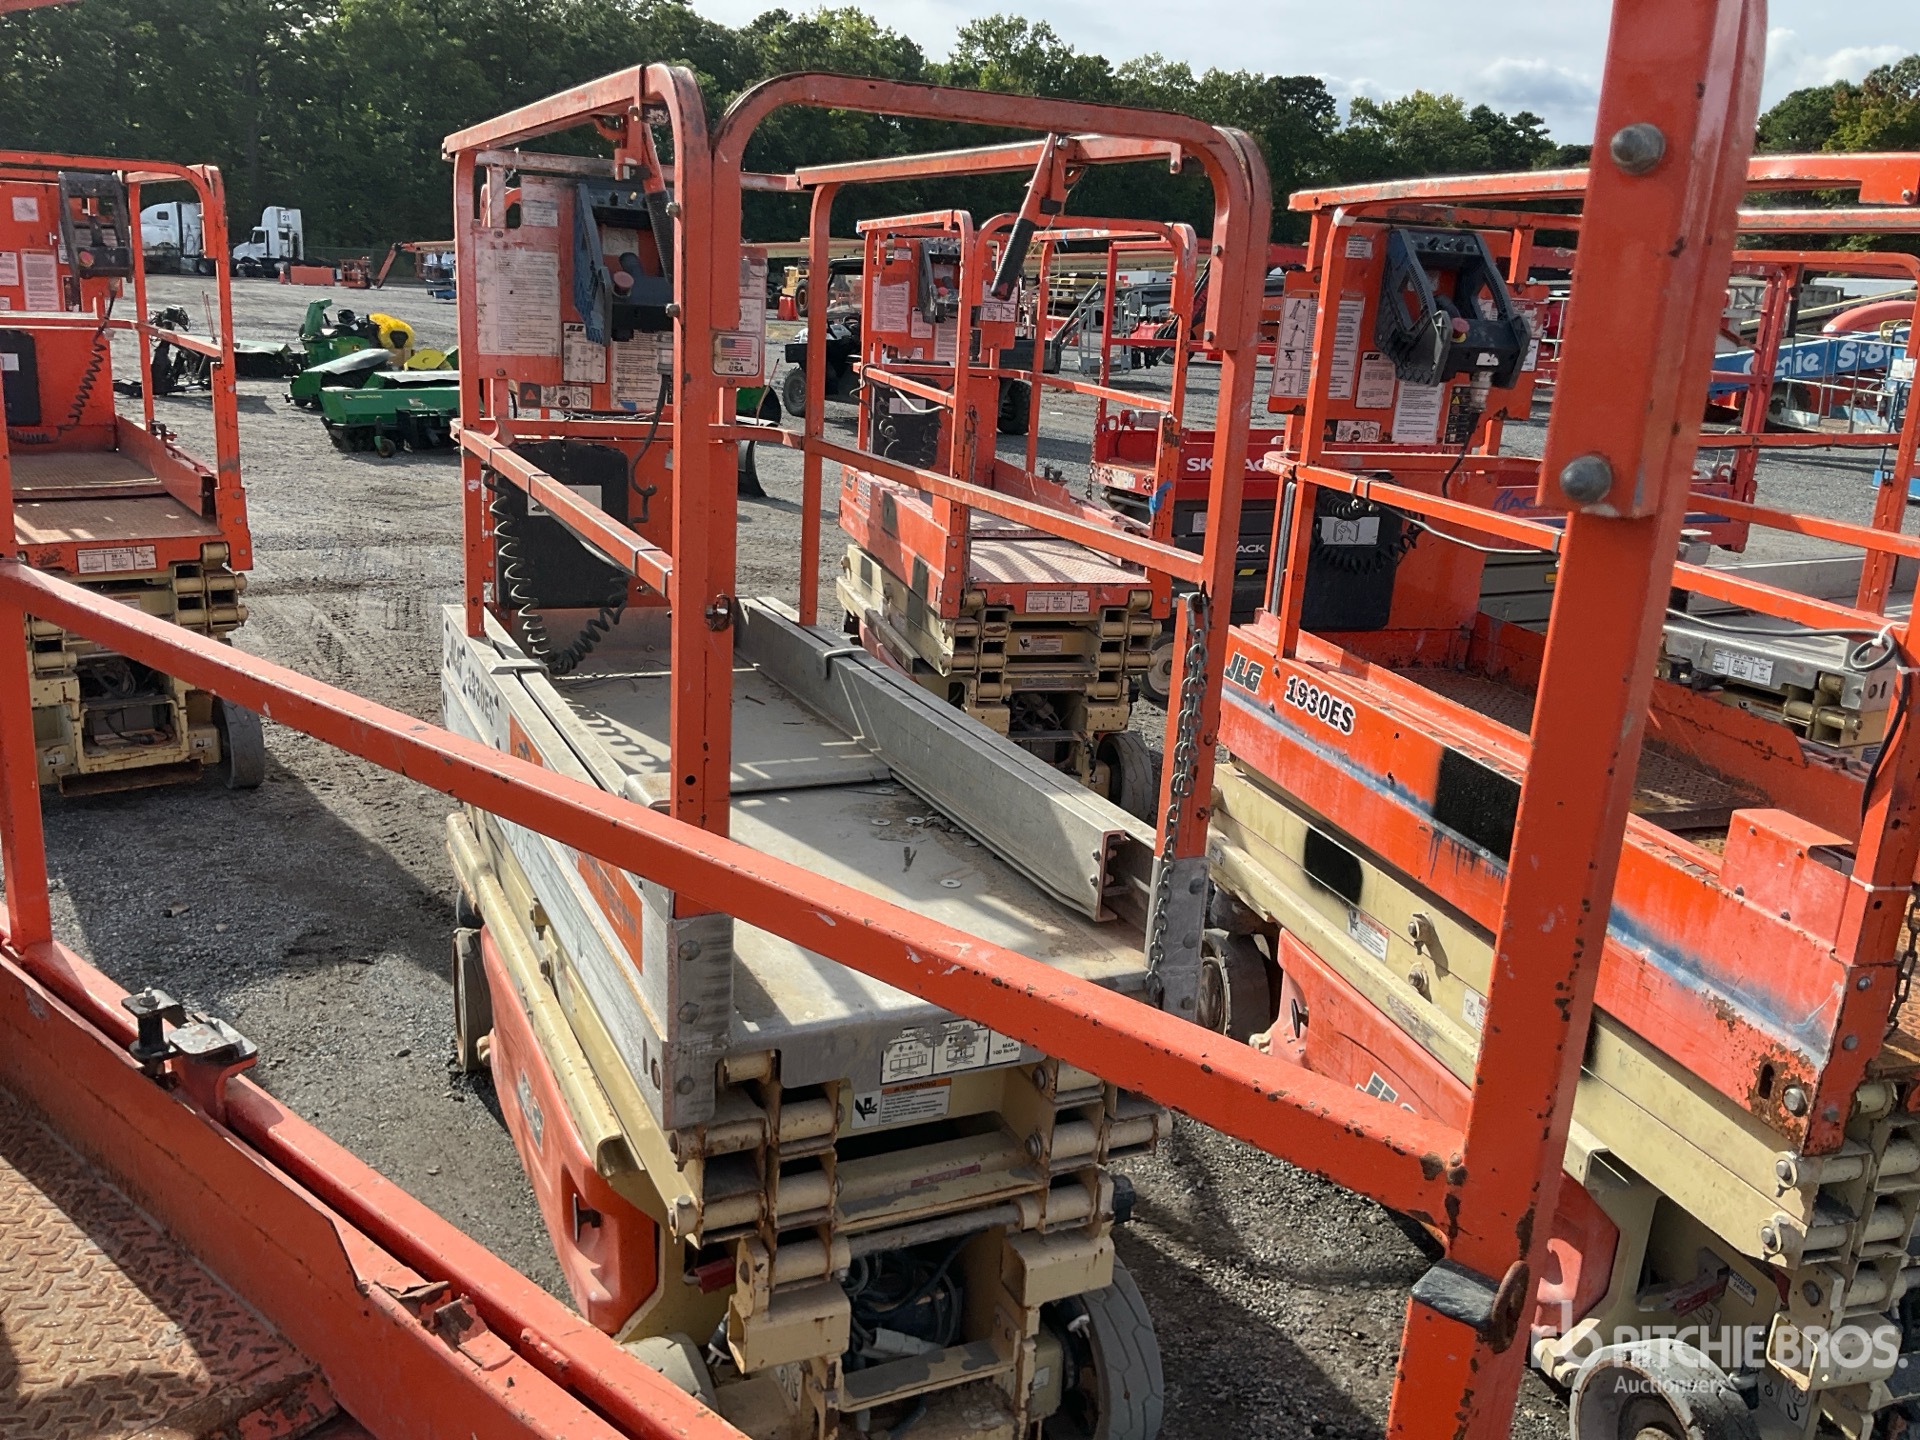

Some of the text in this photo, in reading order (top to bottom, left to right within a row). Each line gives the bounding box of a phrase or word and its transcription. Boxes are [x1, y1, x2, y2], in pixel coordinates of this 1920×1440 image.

[728, 365, 744, 373] USA
[1743, 349, 1819, 376] Gnie
[1224, 651, 1356, 735] JLG 1930ES
